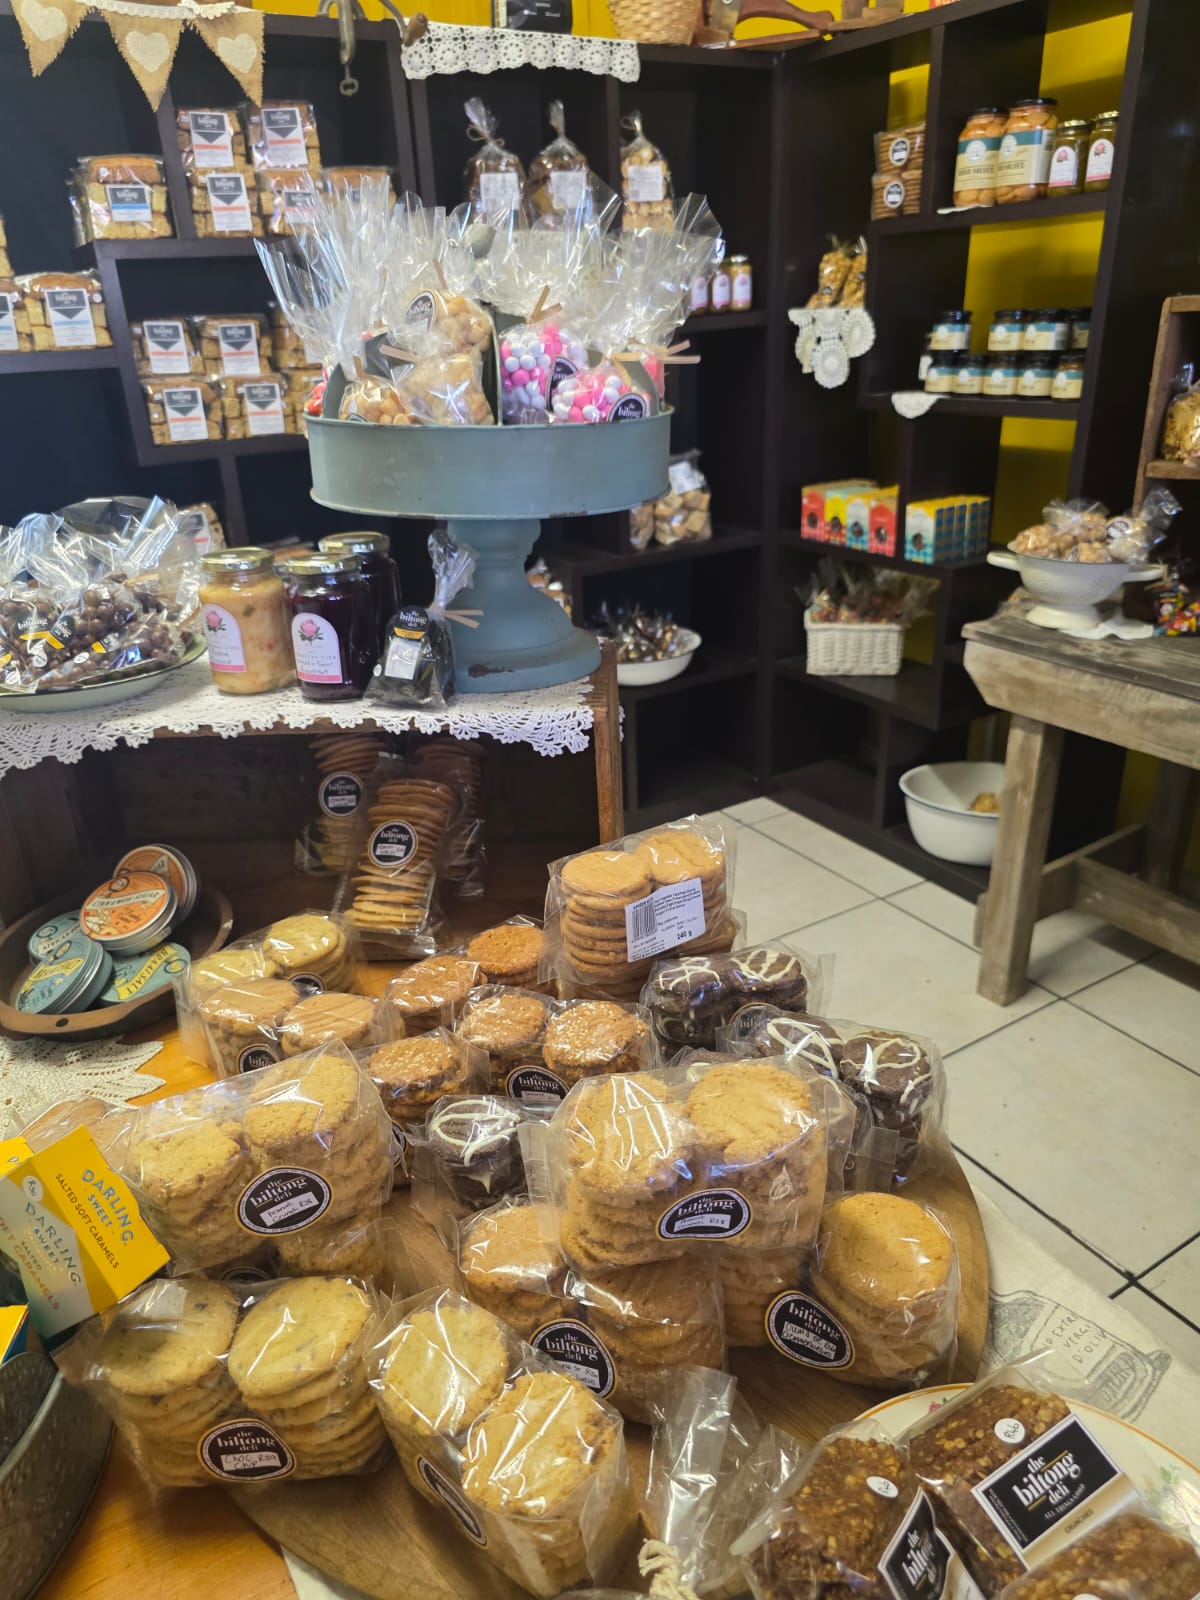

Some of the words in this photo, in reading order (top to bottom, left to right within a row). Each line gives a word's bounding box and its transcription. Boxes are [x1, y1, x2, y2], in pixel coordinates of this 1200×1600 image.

[380, 831, 410, 842] biltong
[518, 1076, 560, 1090] biltong
[250, 1177, 308, 1206] biltong
[267, 1180, 283, 1190] the
[82, 1169, 134, 1243] DARLING
[274, 1190, 293, 1202] deli
[88, 1194, 113, 1228] SWEET
[678, 1201, 736, 1216] biltong
[56, 1173, 77, 1205] SALTED
[75, 1203, 92, 1226] SOFT
[89, 1225, 120, 1269] CARAMELS
[25, 1202, 82, 1284] DARLING
[33, 1228, 60, 1264] SWEET
[789, 1302, 841, 1340] biltong
[804, 1321, 821, 1335] deli
[564, 1333, 579, 1342] the
[545, 1337, 599, 1360] biltong
[565, 1351, 581, 1361] deli
[217, 1436, 277, 1447] biltong
[1027, 1456, 1046, 1474] the
[1011, 1452, 1081, 1508] biltong
[1048, 1481, 1071, 1505] deli
